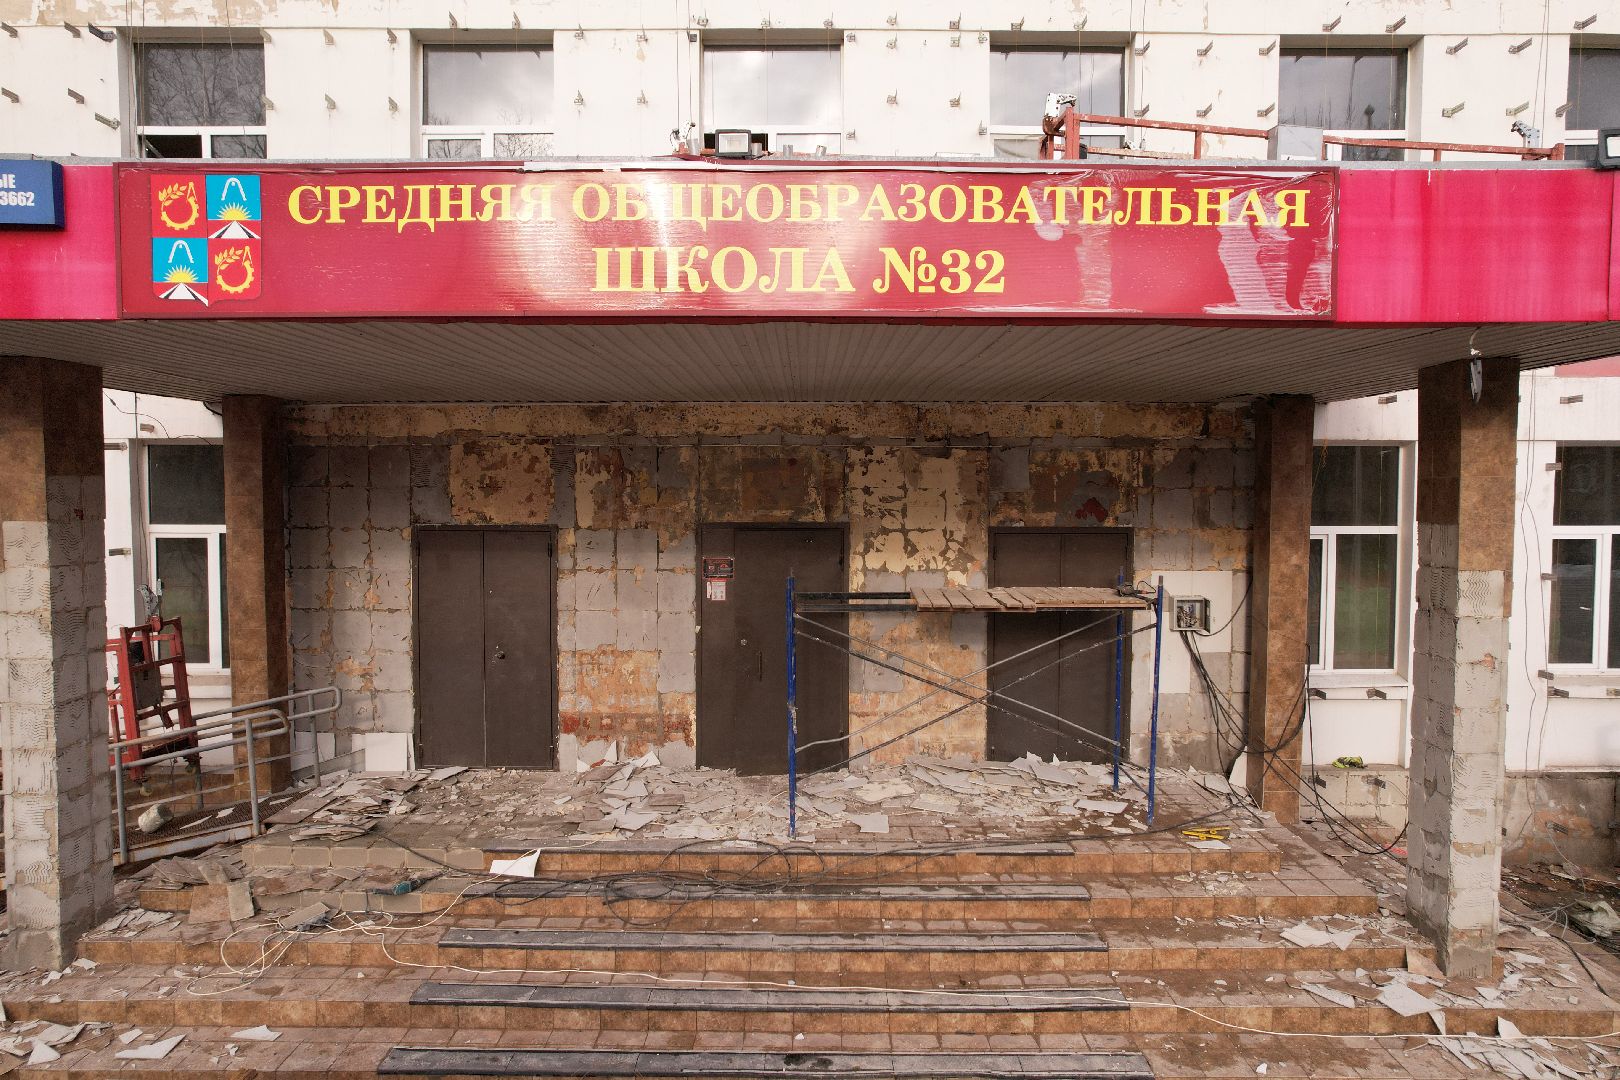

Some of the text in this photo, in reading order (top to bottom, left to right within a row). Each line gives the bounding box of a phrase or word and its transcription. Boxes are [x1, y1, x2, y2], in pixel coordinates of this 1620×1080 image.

[288, 183, 1311, 233] СРЕДНЯЯ ОБЩЕОБРАЗОВАТЕЛЬНАЯ
[589, 245, 1006, 295] ШКОЛА №32
